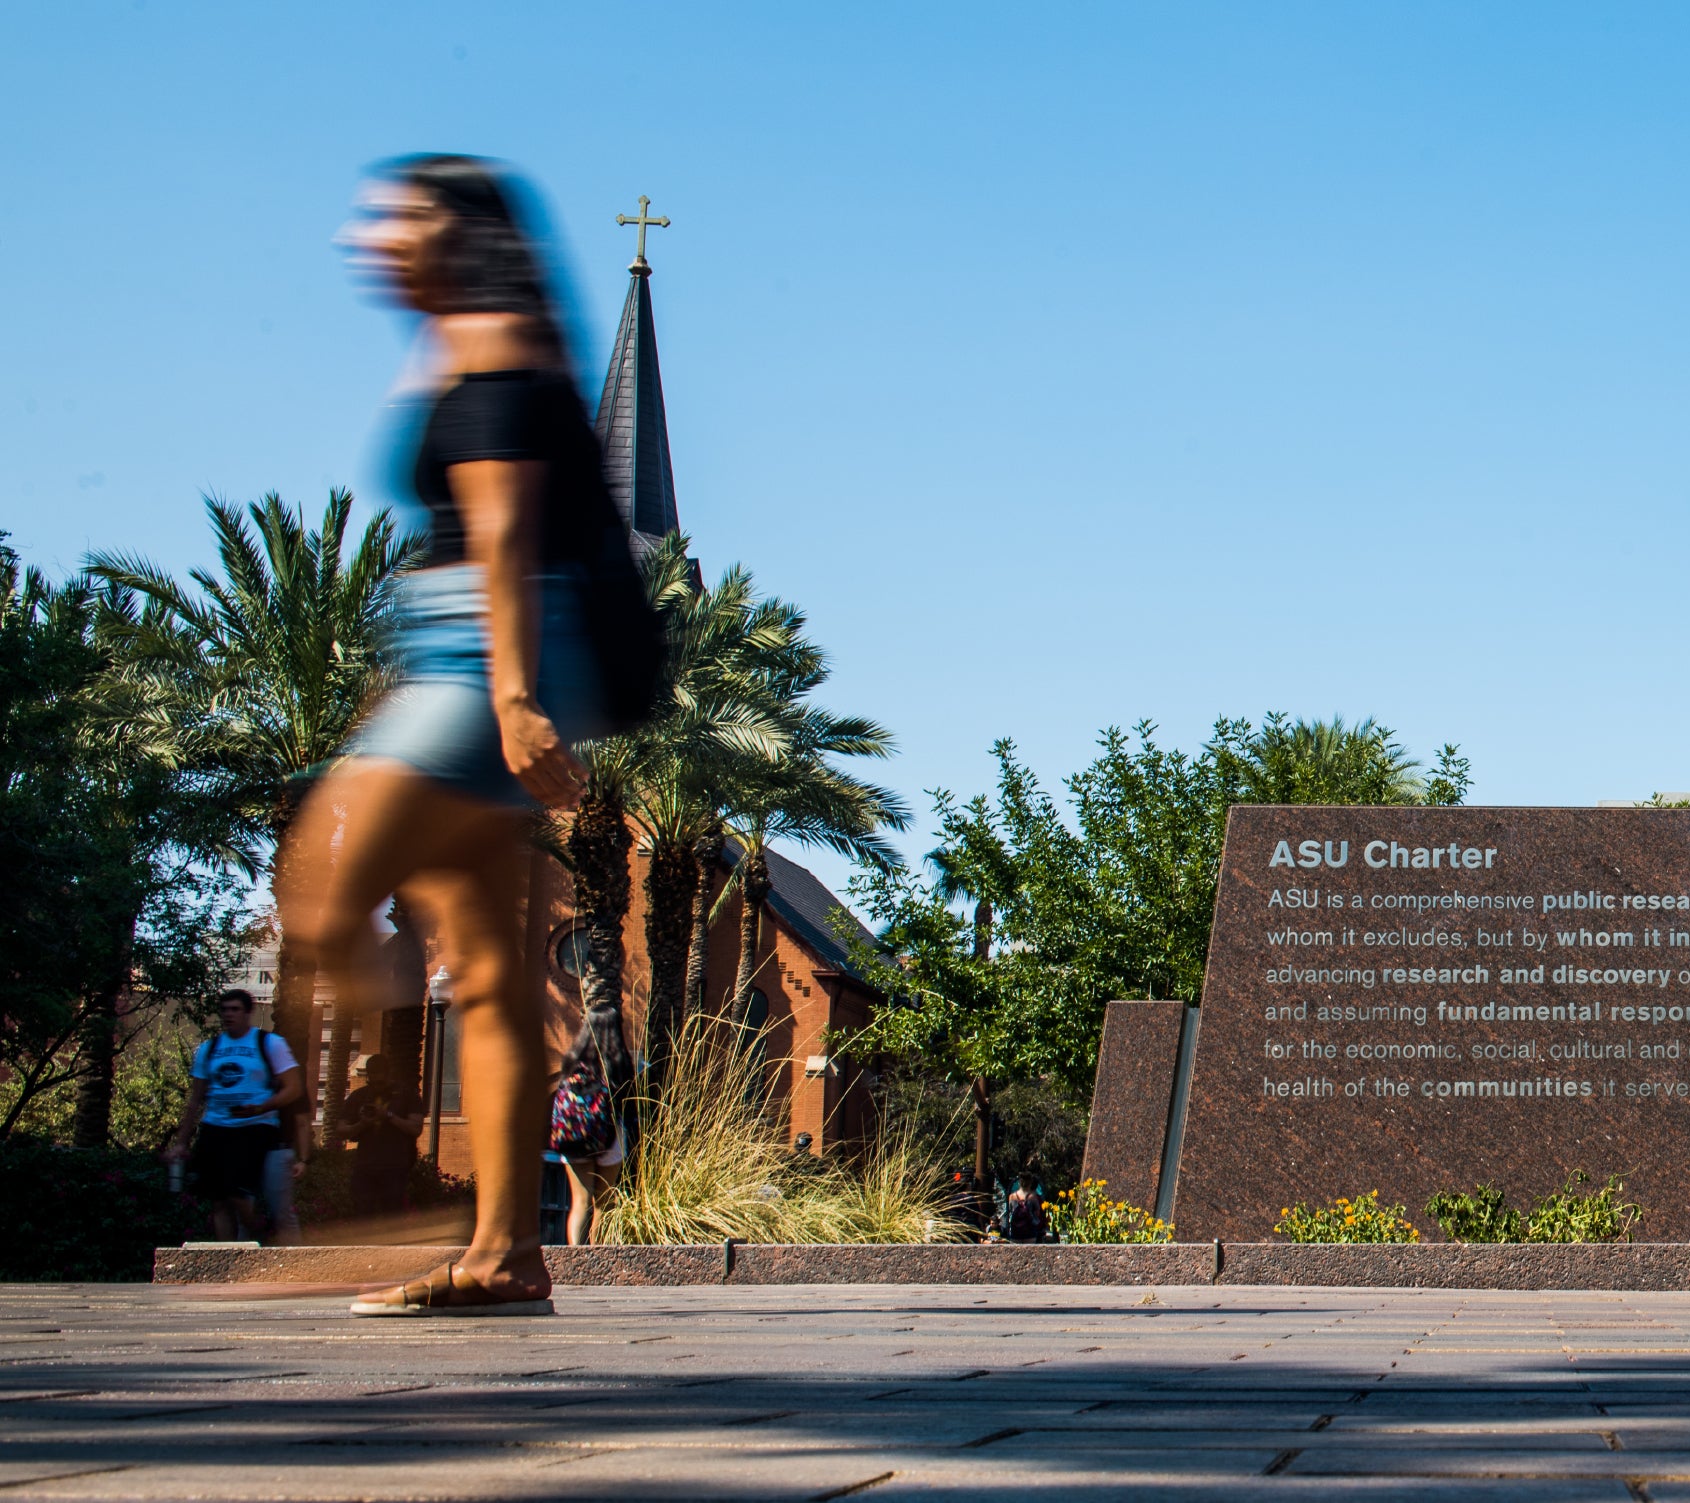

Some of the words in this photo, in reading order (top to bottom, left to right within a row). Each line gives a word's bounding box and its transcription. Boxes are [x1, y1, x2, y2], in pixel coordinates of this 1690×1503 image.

[1269, 840, 1349, 869] ASU
[1364, 840, 1498, 869] Charter
[1268, 889, 1318, 909] ASU
[1327, 890, 1343, 909] is
[1351, 895, 1364, 909] a
[1371, 890, 1535, 914] comprehensive
[1542, 891, 1615, 914] public
[1267, 926, 1333, 947] whom
[1342, 926, 1356, 947] it
[1363, 927, 1469, 950] excludes,
[1477, 927, 1514, 947] but
[1522, 928, 1548, 951] by
[1556, 928, 1635, 947] whom
[1644, 928, 1661, 947] it
[1266, 965, 1375, 989] advancing
[1383, 964, 1489, 984] research
[1500, 964, 1544, 984] and
[1552, 965, 1671, 989] discovery
[1265, 1001, 1307, 1021] and
[1317, 1003, 1427, 1026] assuming
[1438, 1001, 1600, 1022] fundamental
[1263, 1039, 1293, 1059] for
[1302, 1039, 1337, 1059] the
[1346, 1040, 1462, 1061] economic,
[1549, 1039, 1632, 1059] cultural
[1640, 1040, 1680, 1059] and
[1263, 1077, 1334, 1096] health
[1344, 1077, 1367, 1096] of
[1375, 1077, 1410, 1096] the
[1420, 1077, 1593, 1097] communities
[1603, 1079, 1615, 1097] it
